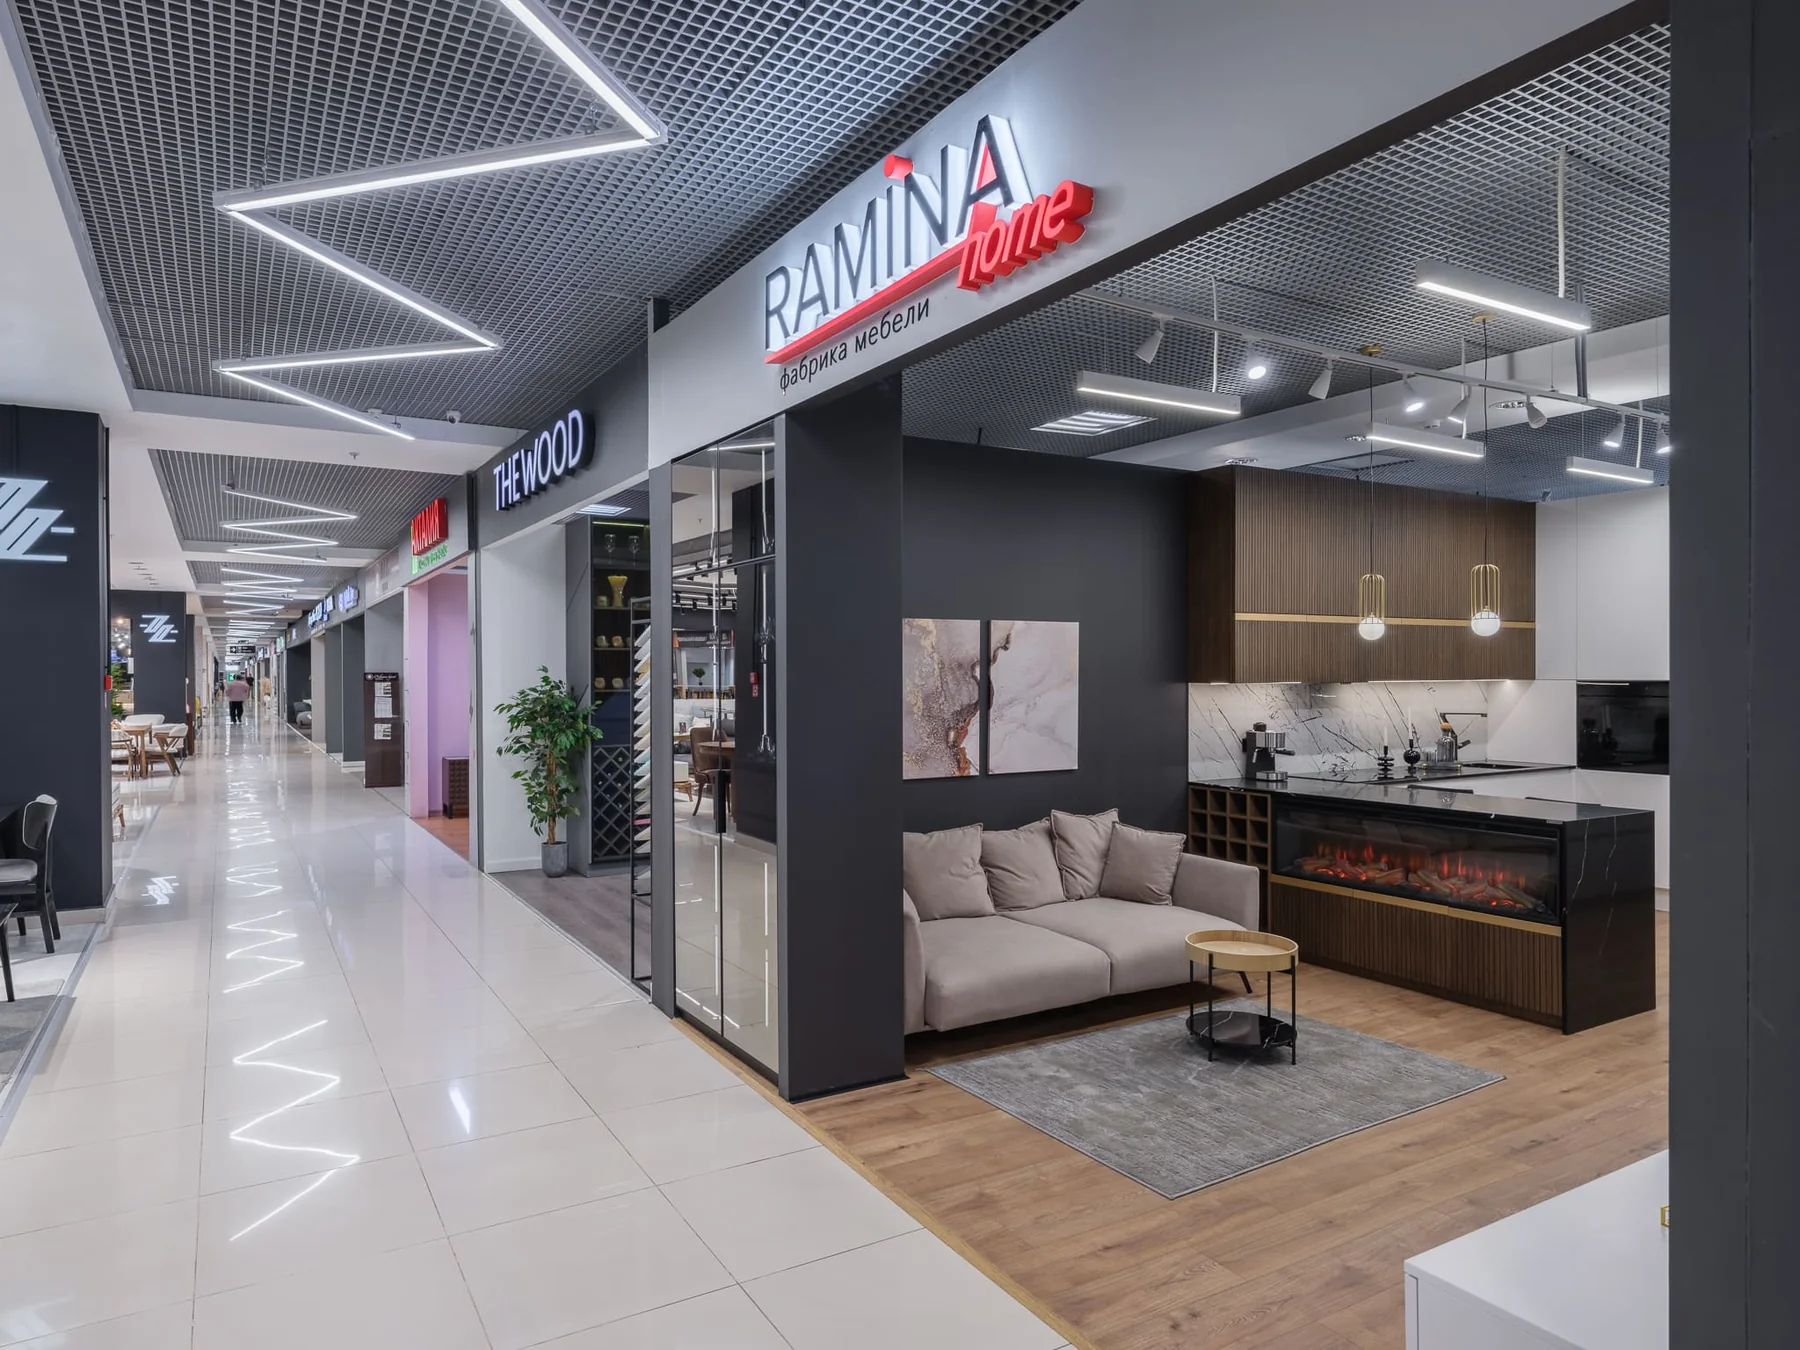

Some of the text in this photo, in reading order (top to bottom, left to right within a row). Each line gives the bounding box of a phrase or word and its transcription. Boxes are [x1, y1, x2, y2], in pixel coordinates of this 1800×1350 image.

[956, 179, 1093, 291] home
[779, 297, 930, 394] фабрика мебели
